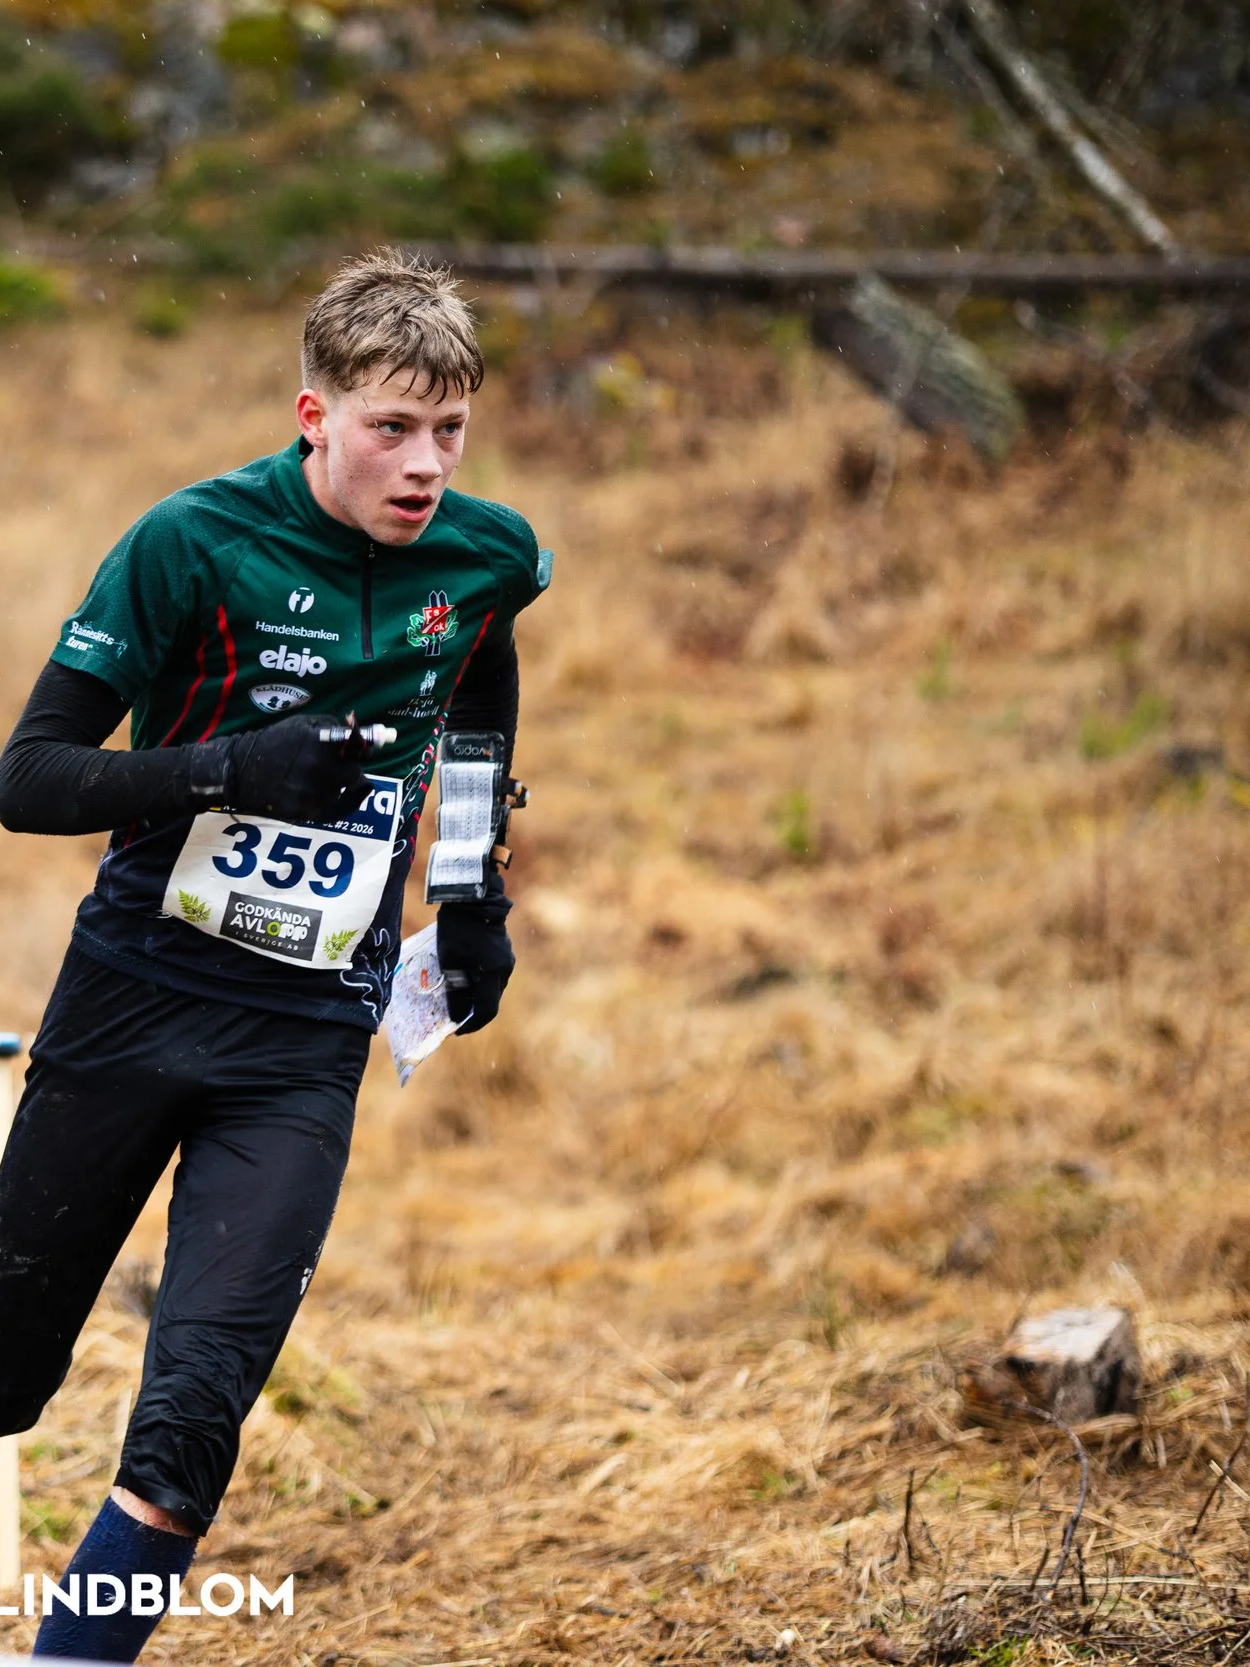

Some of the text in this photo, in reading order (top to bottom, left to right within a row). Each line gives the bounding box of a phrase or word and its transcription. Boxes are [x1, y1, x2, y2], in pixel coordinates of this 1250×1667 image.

[255, 621, 340, 641] Handelsbanken
[259, 645, 327, 678] elajo
[334, 820, 350, 831] #2
[350, 822, 374, 835] 2026
[212, 822, 355, 898] 359
[235, 901, 311, 927] GODKÄNDA
